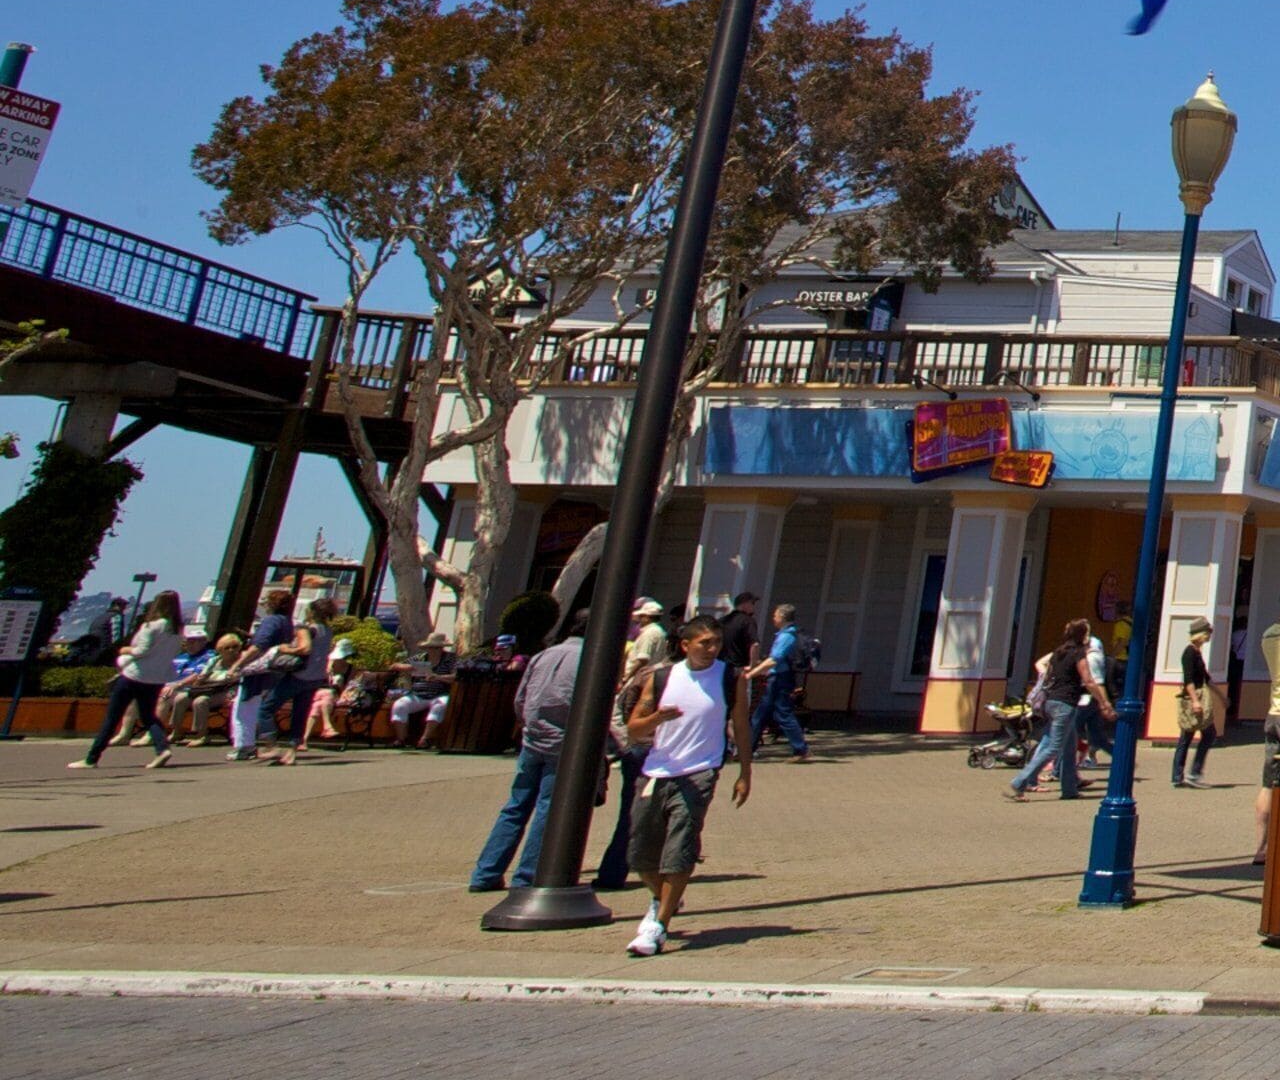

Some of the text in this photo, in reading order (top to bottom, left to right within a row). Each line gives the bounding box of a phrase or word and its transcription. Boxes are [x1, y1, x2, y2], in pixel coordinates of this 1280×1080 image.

[11, 94, 50, 112] AWAY
[11, 131, 41, 148] CAR
[10, 144, 41, 161] ZONE
[799, 290, 843, 302] OYSTER
